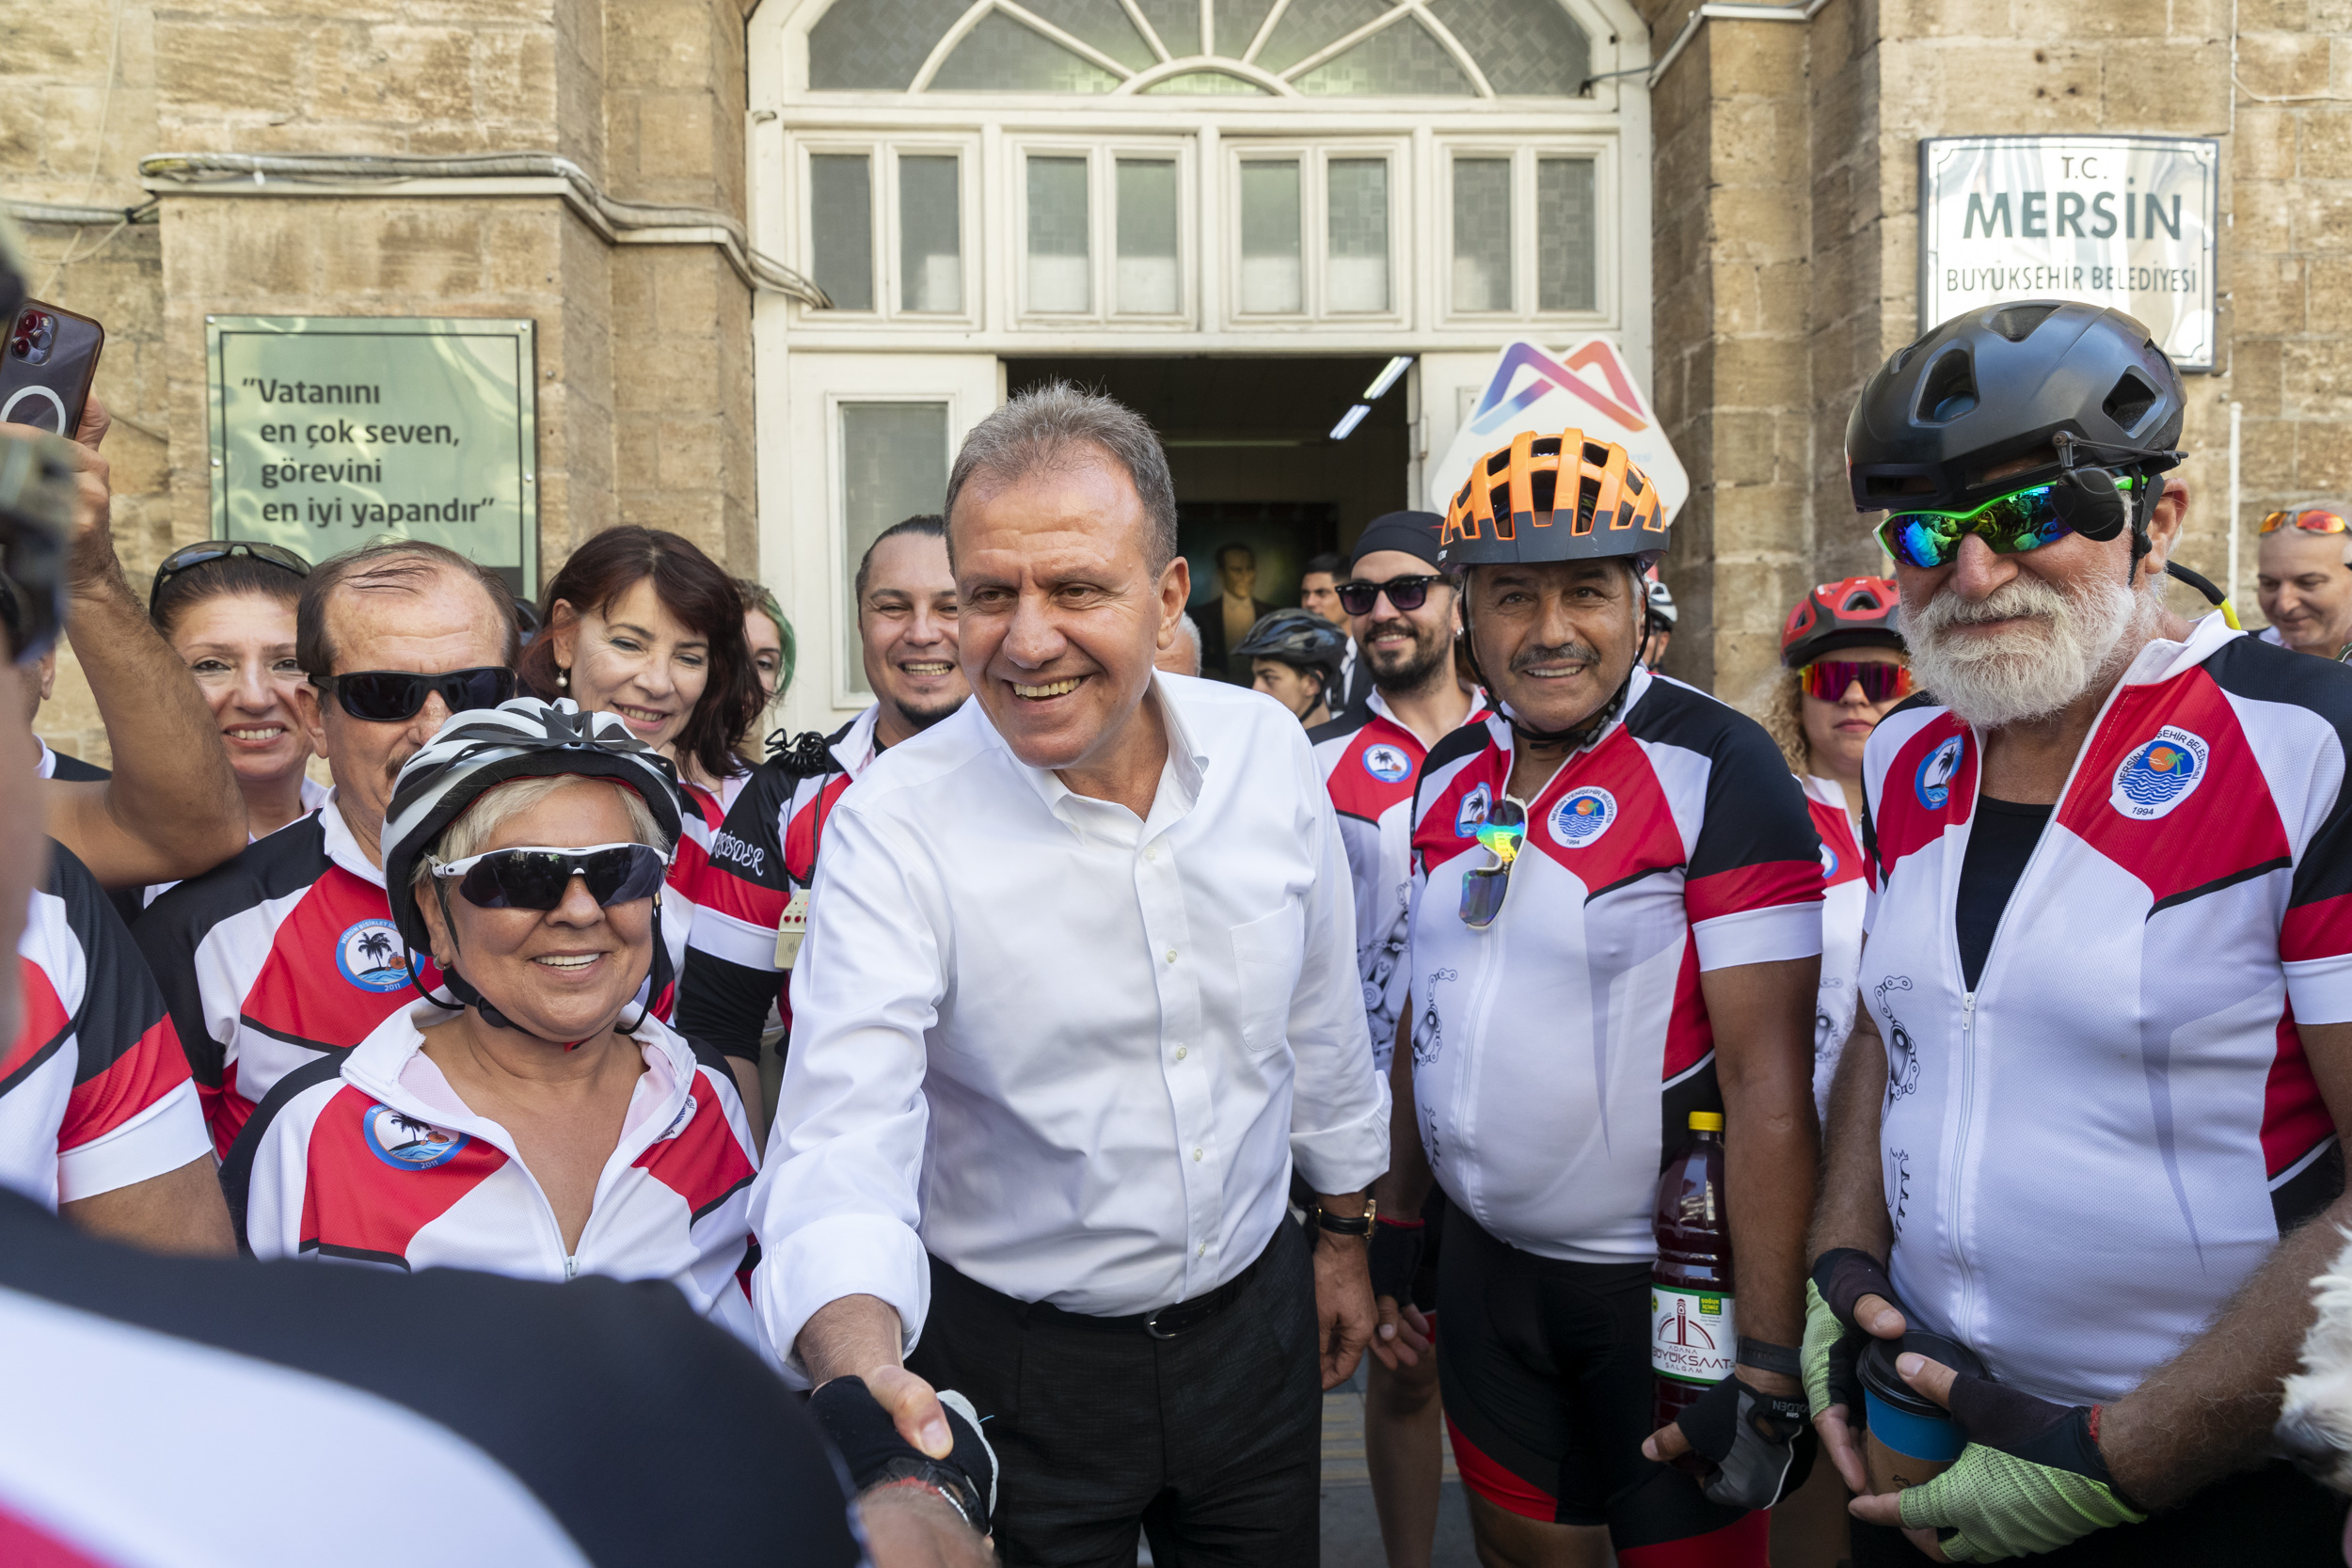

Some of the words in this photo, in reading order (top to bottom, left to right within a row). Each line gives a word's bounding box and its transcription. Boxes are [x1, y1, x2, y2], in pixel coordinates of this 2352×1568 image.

[2061, 156, 2107, 179] T.C.
[1963, 176, 2182, 240] MERSİN
[2092, 261, 2197, 293] BELEDİYESİ
[260, 423, 296, 444] en
[306, 419, 355, 450] çok
[365, 423, 460, 448] seven,
[261, 458, 382, 489] görevini
[262, 501, 298, 522] en
[308, 498, 342, 529] iyi
[2132, 806, 2154, 816] 1994
[341, 927, 359, 944] MERSİN
[358, 921, 388, 930] BİSİKLET
[384, 983, 401, 991] 2011
[420, 1160, 439, 1169] 2011
[1668, 1345, 1698, 1355] ADANA
[1772, 1400, 1807, 1413] OLDEN
